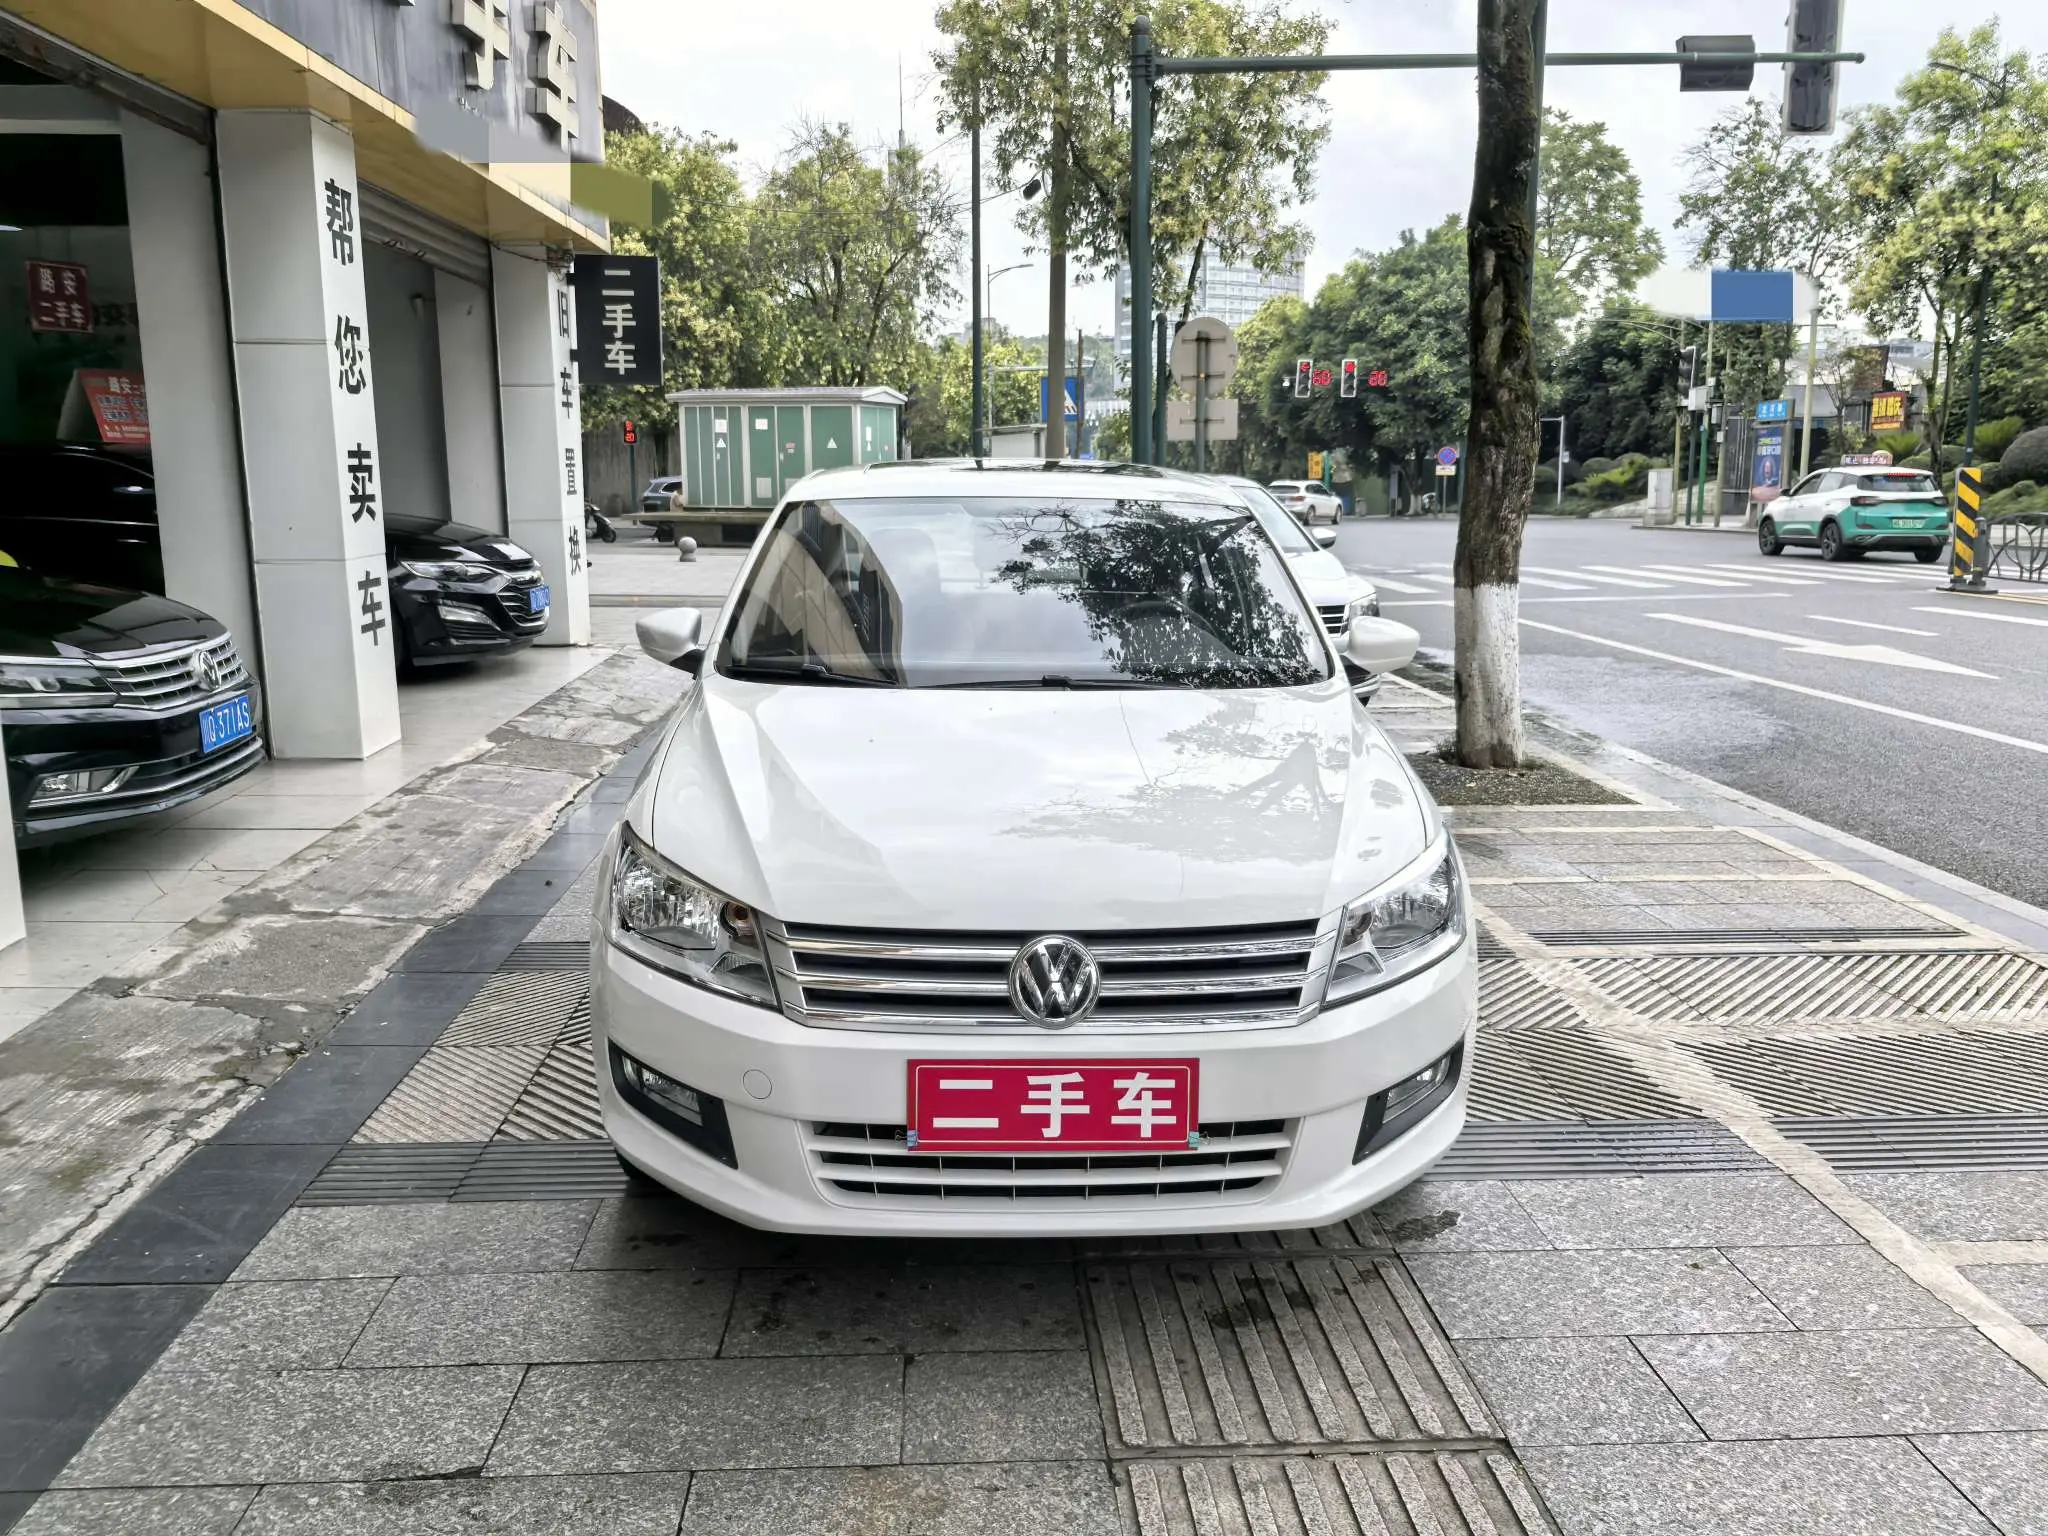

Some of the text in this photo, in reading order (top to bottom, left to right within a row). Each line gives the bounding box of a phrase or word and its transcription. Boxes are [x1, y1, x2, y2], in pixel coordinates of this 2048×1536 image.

[324, 178, 386, 646] 帮您卖车
[602, 269, 637, 375] 二手车
[557, 289, 582, 576] 旧车置换
[932, 1072, 1177, 1138] 二手车
